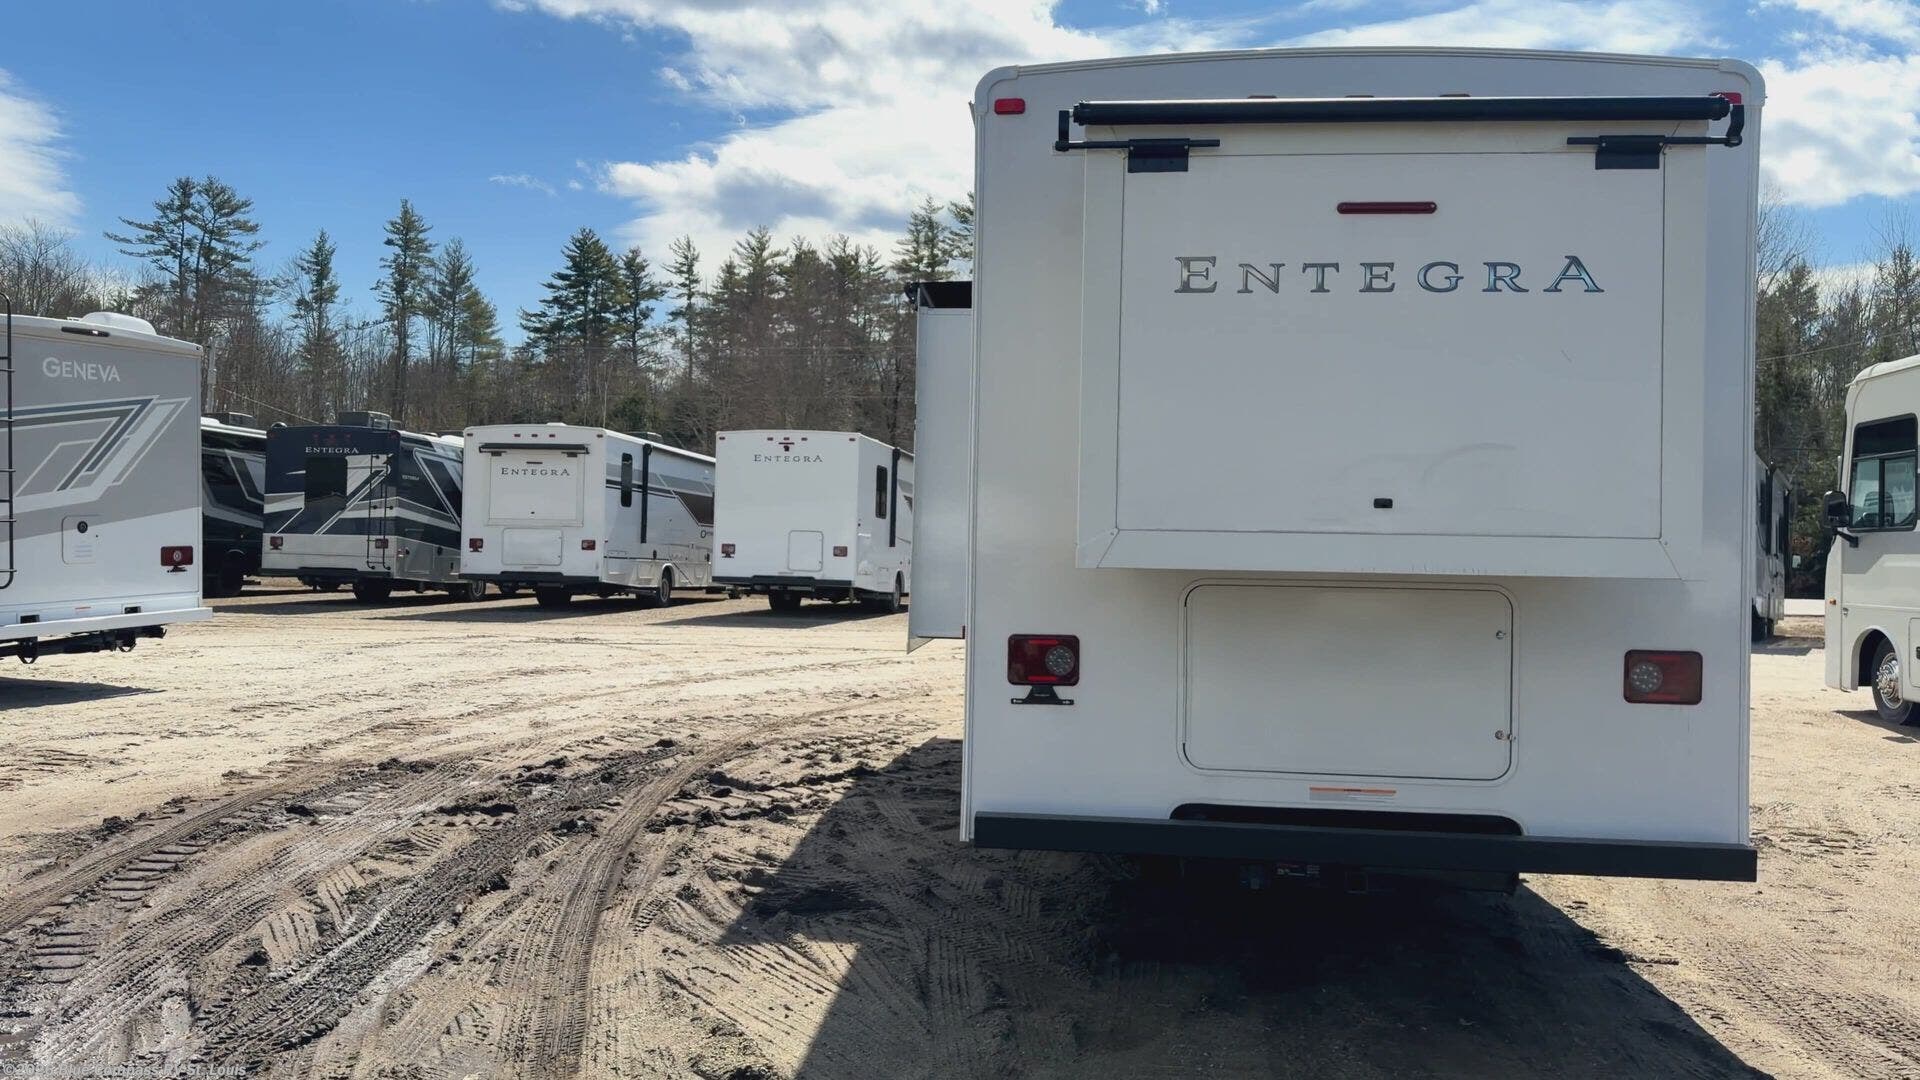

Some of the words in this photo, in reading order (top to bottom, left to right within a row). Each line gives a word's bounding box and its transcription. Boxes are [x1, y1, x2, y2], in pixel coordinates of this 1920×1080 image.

[1174, 255, 1605, 294] ENTEGRA
[42, 357, 121, 382] GENEVA
[305, 446, 360, 454] ENTEGRA
[753, 454, 823, 463] ENTEGRA
[501, 467, 571, 476] ENTEGRA
